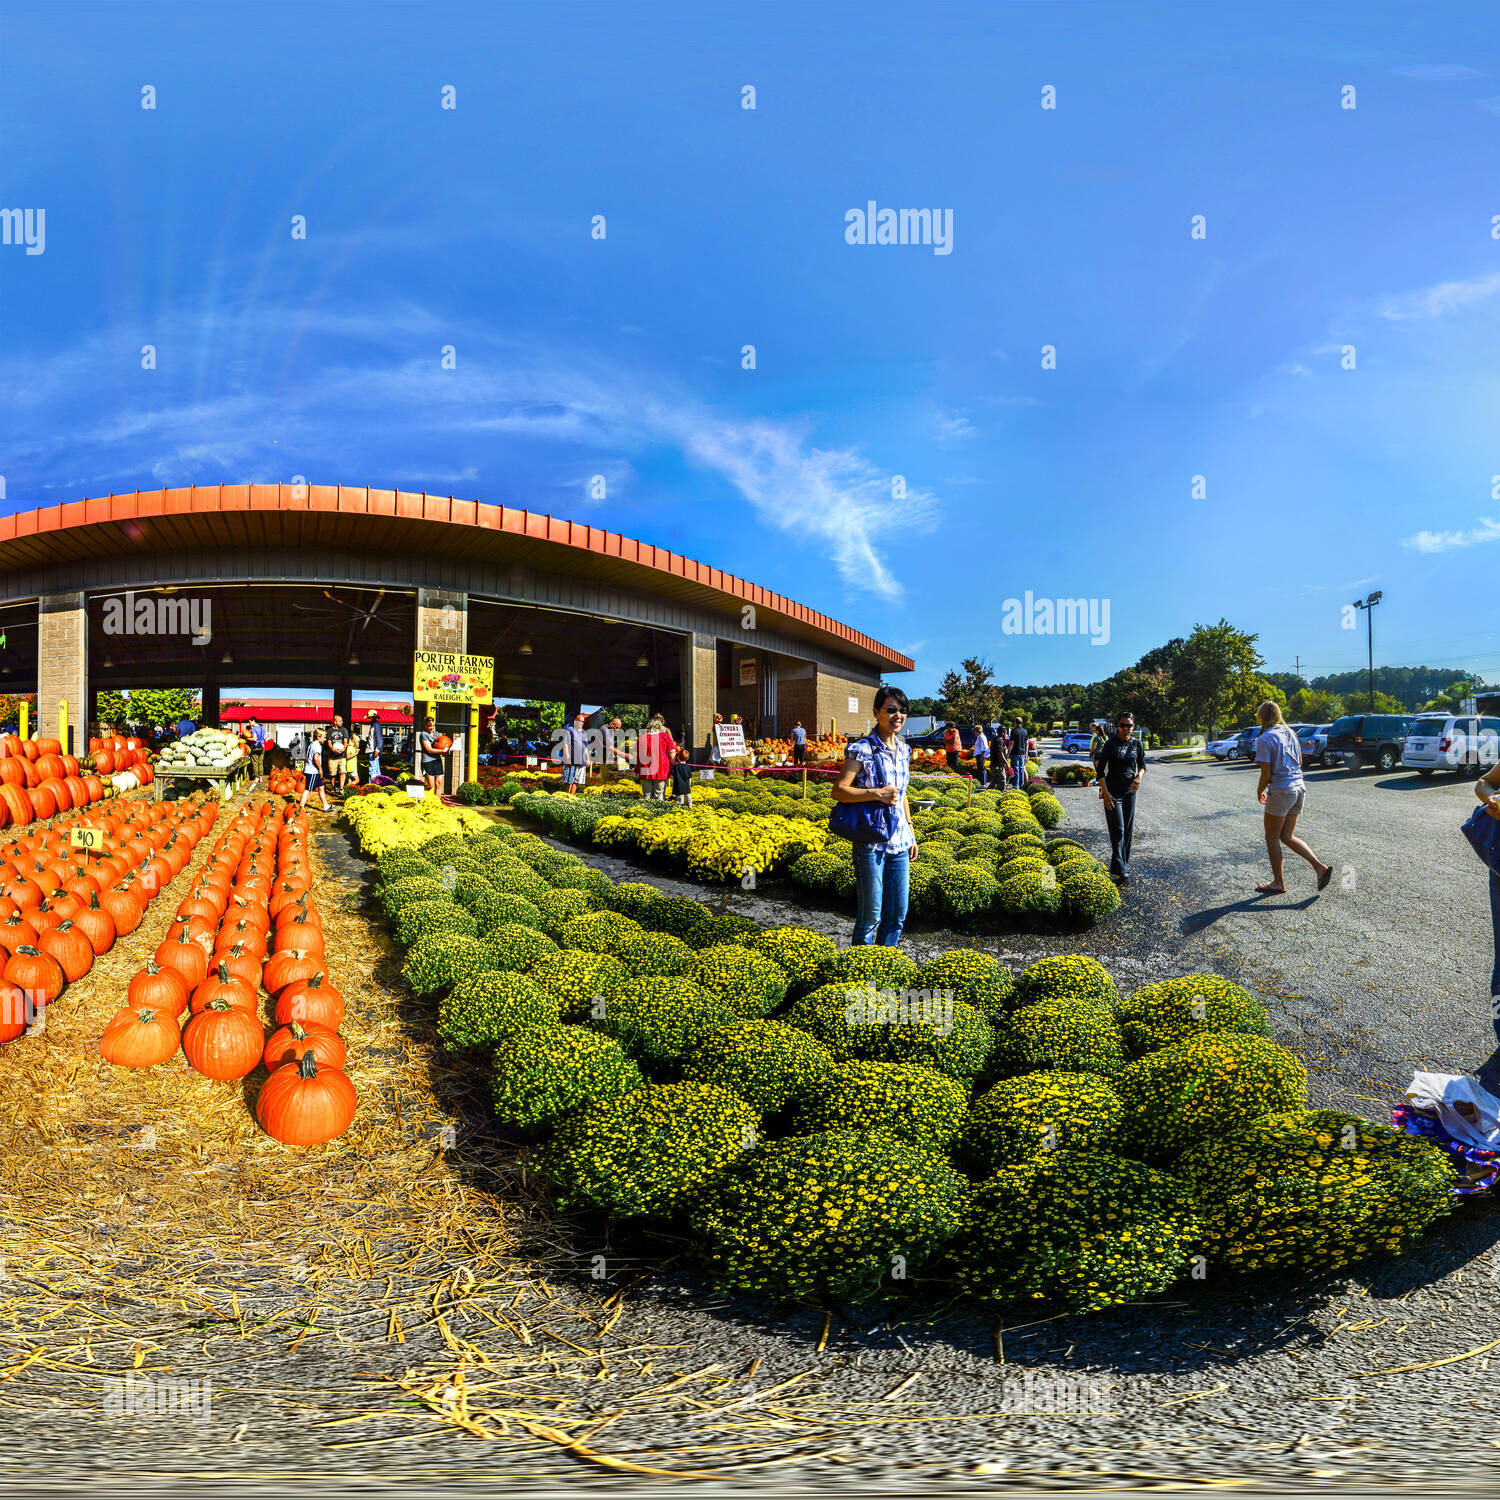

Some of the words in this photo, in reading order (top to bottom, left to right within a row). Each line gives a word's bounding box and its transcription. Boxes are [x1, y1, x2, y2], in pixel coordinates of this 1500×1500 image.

[415, 652, 455, 665] PORTER
[460, 656, 494, 669] FARMS
[427, 664, 444, 672] AND
[447, 665, 482, 675] NURSERY
[434, 693, 463, 702] RALEIGH,
[77, 830, 94, 847] $10
